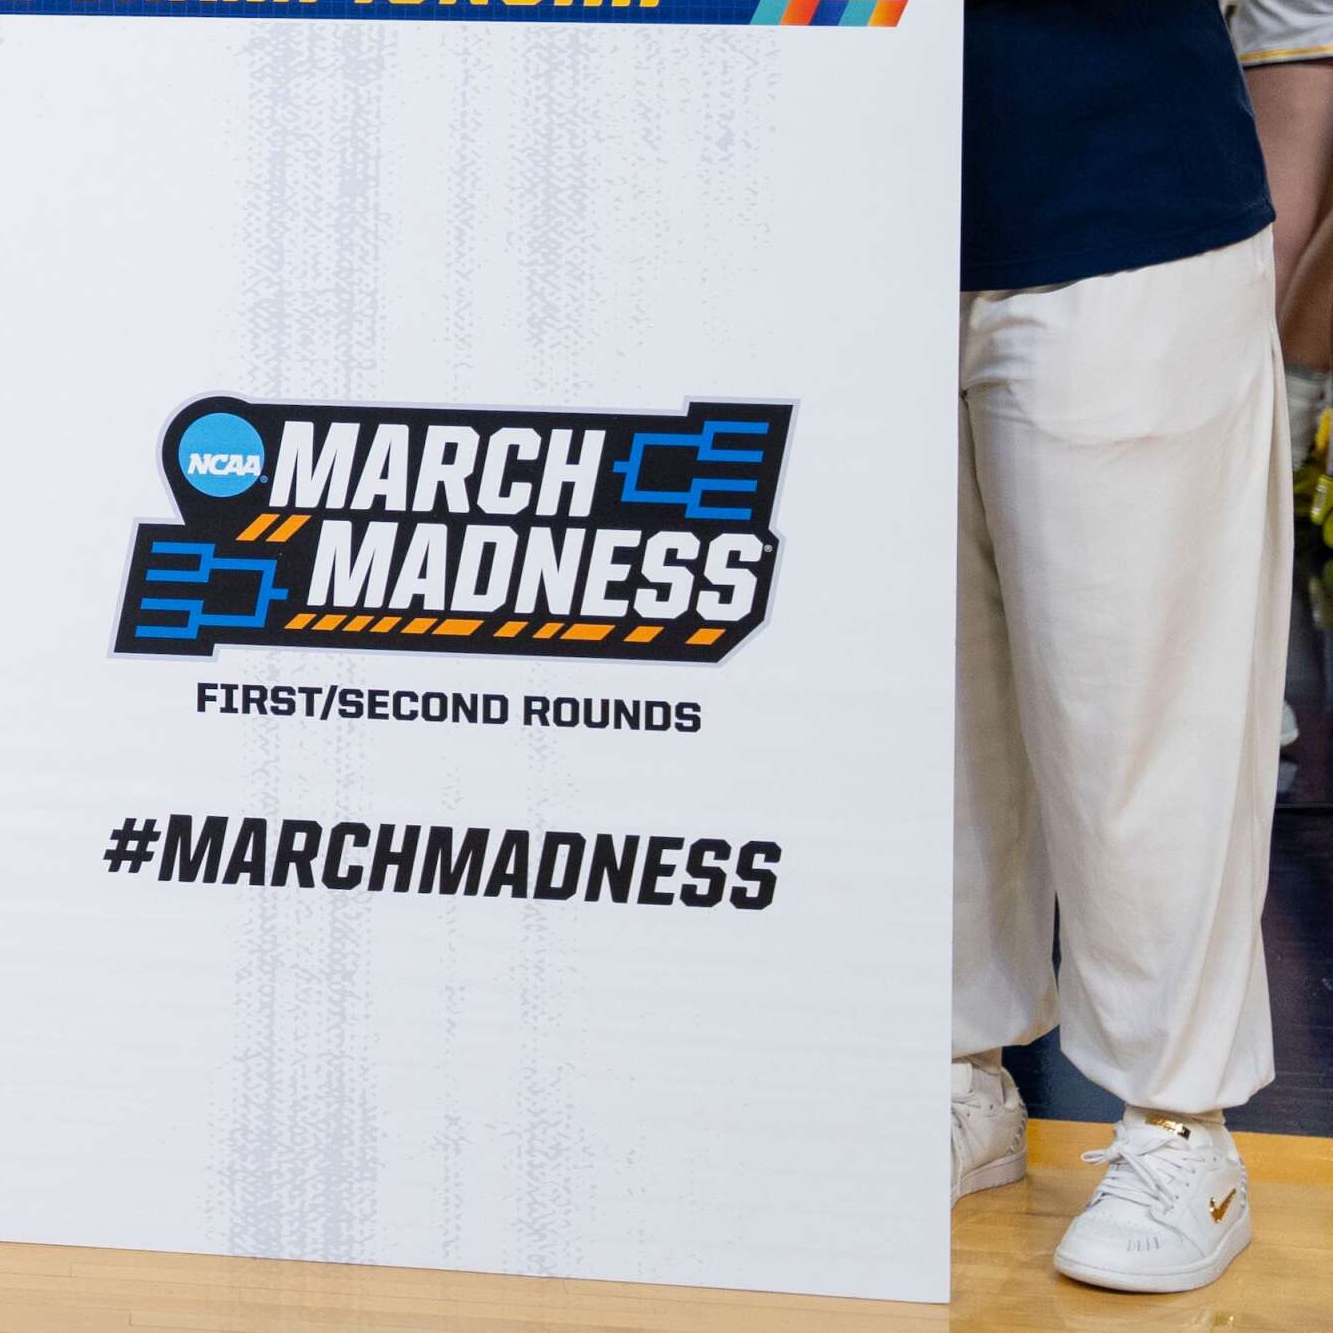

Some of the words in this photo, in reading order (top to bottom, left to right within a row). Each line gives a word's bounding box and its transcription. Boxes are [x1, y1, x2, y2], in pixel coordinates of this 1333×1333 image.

[186, 453, 262, 477] NCAA
[269, 420, 606, 517] MARCH
[306, 520, 762, 622] MADNESS
[196, 682, 509, 727] FIRST/SECOND
[523, 696, 702, 733] ROUNDS
[103, 814, 782, 911] #MARCHMADNESS
